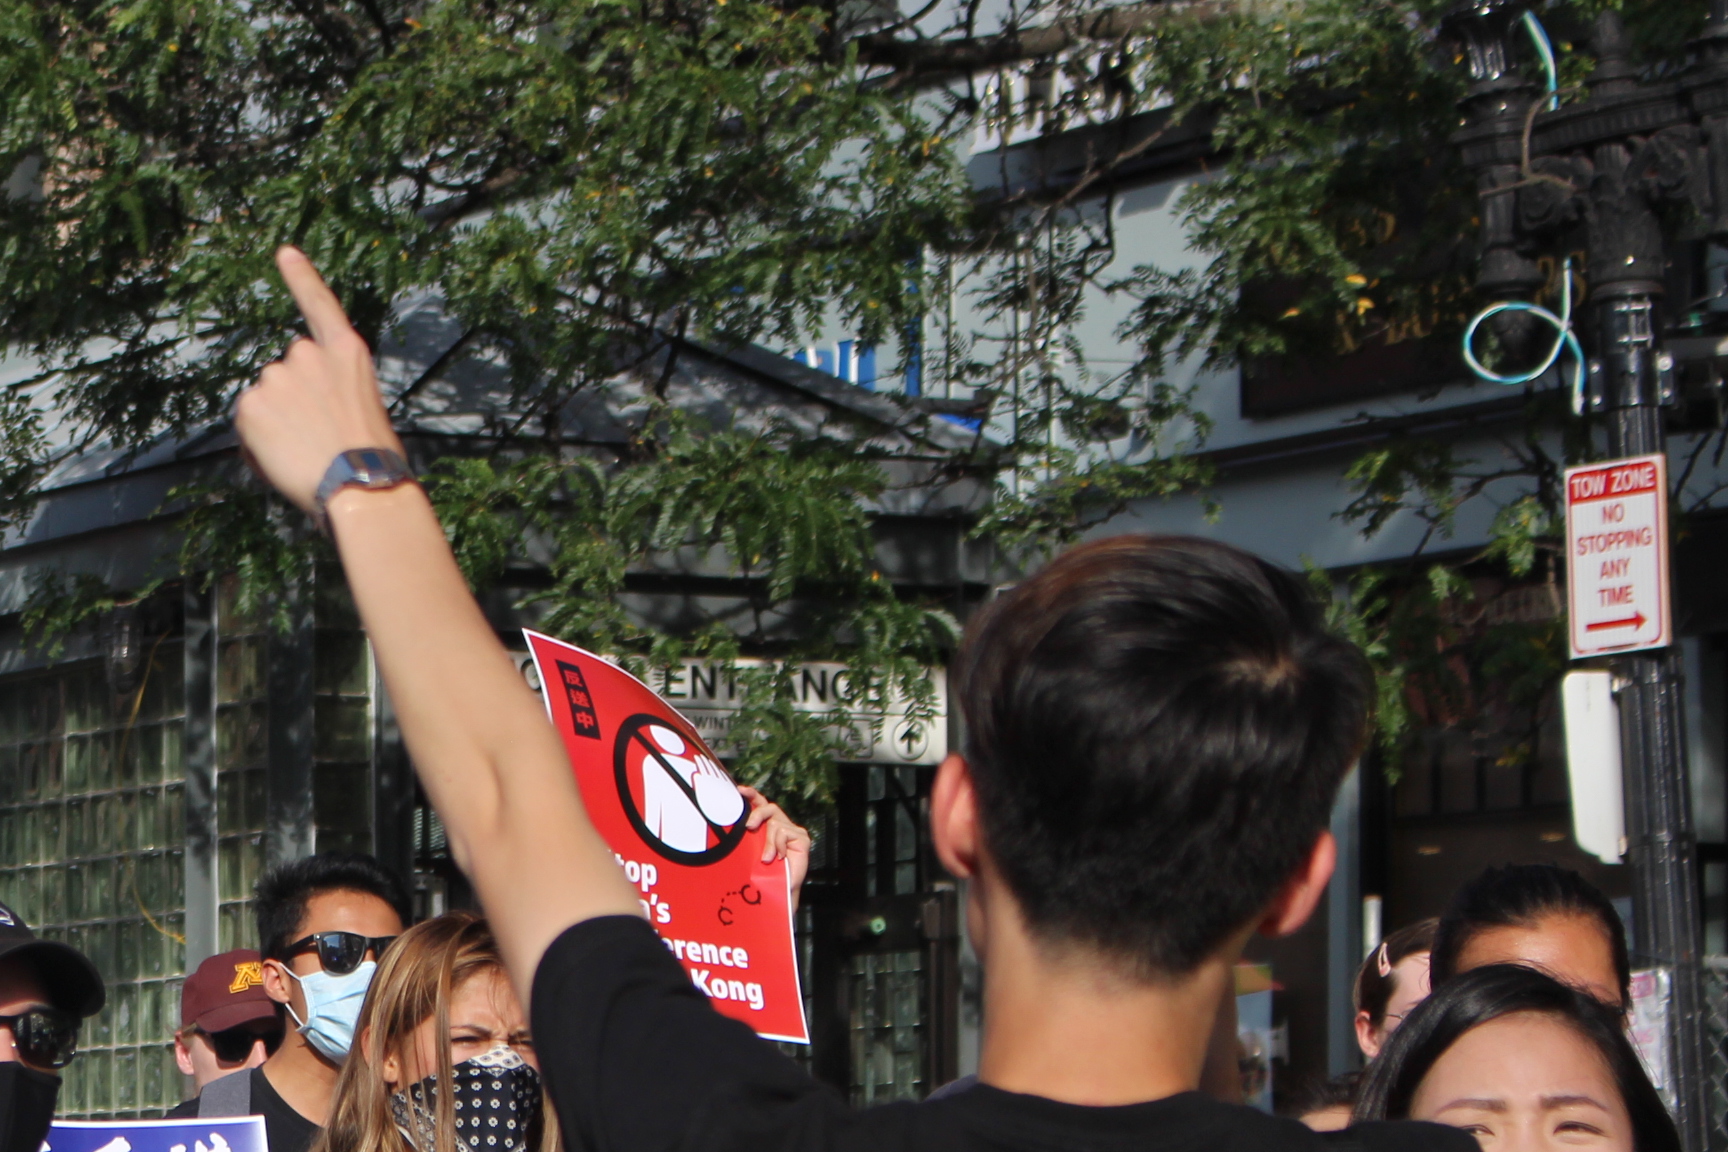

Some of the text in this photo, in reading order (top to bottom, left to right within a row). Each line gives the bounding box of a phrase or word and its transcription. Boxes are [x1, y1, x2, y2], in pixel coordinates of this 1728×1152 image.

[1571, 465, 1656, 498] TOW ZONE
[1603, 503, 1625, 525] NO
[1577, 526, 1653, 556] STOPPING
[1600, 557, 1631, 580] ANY
[1598, 584, 1635, 608] TIME
[690, 968, 765, 1011] Kong
